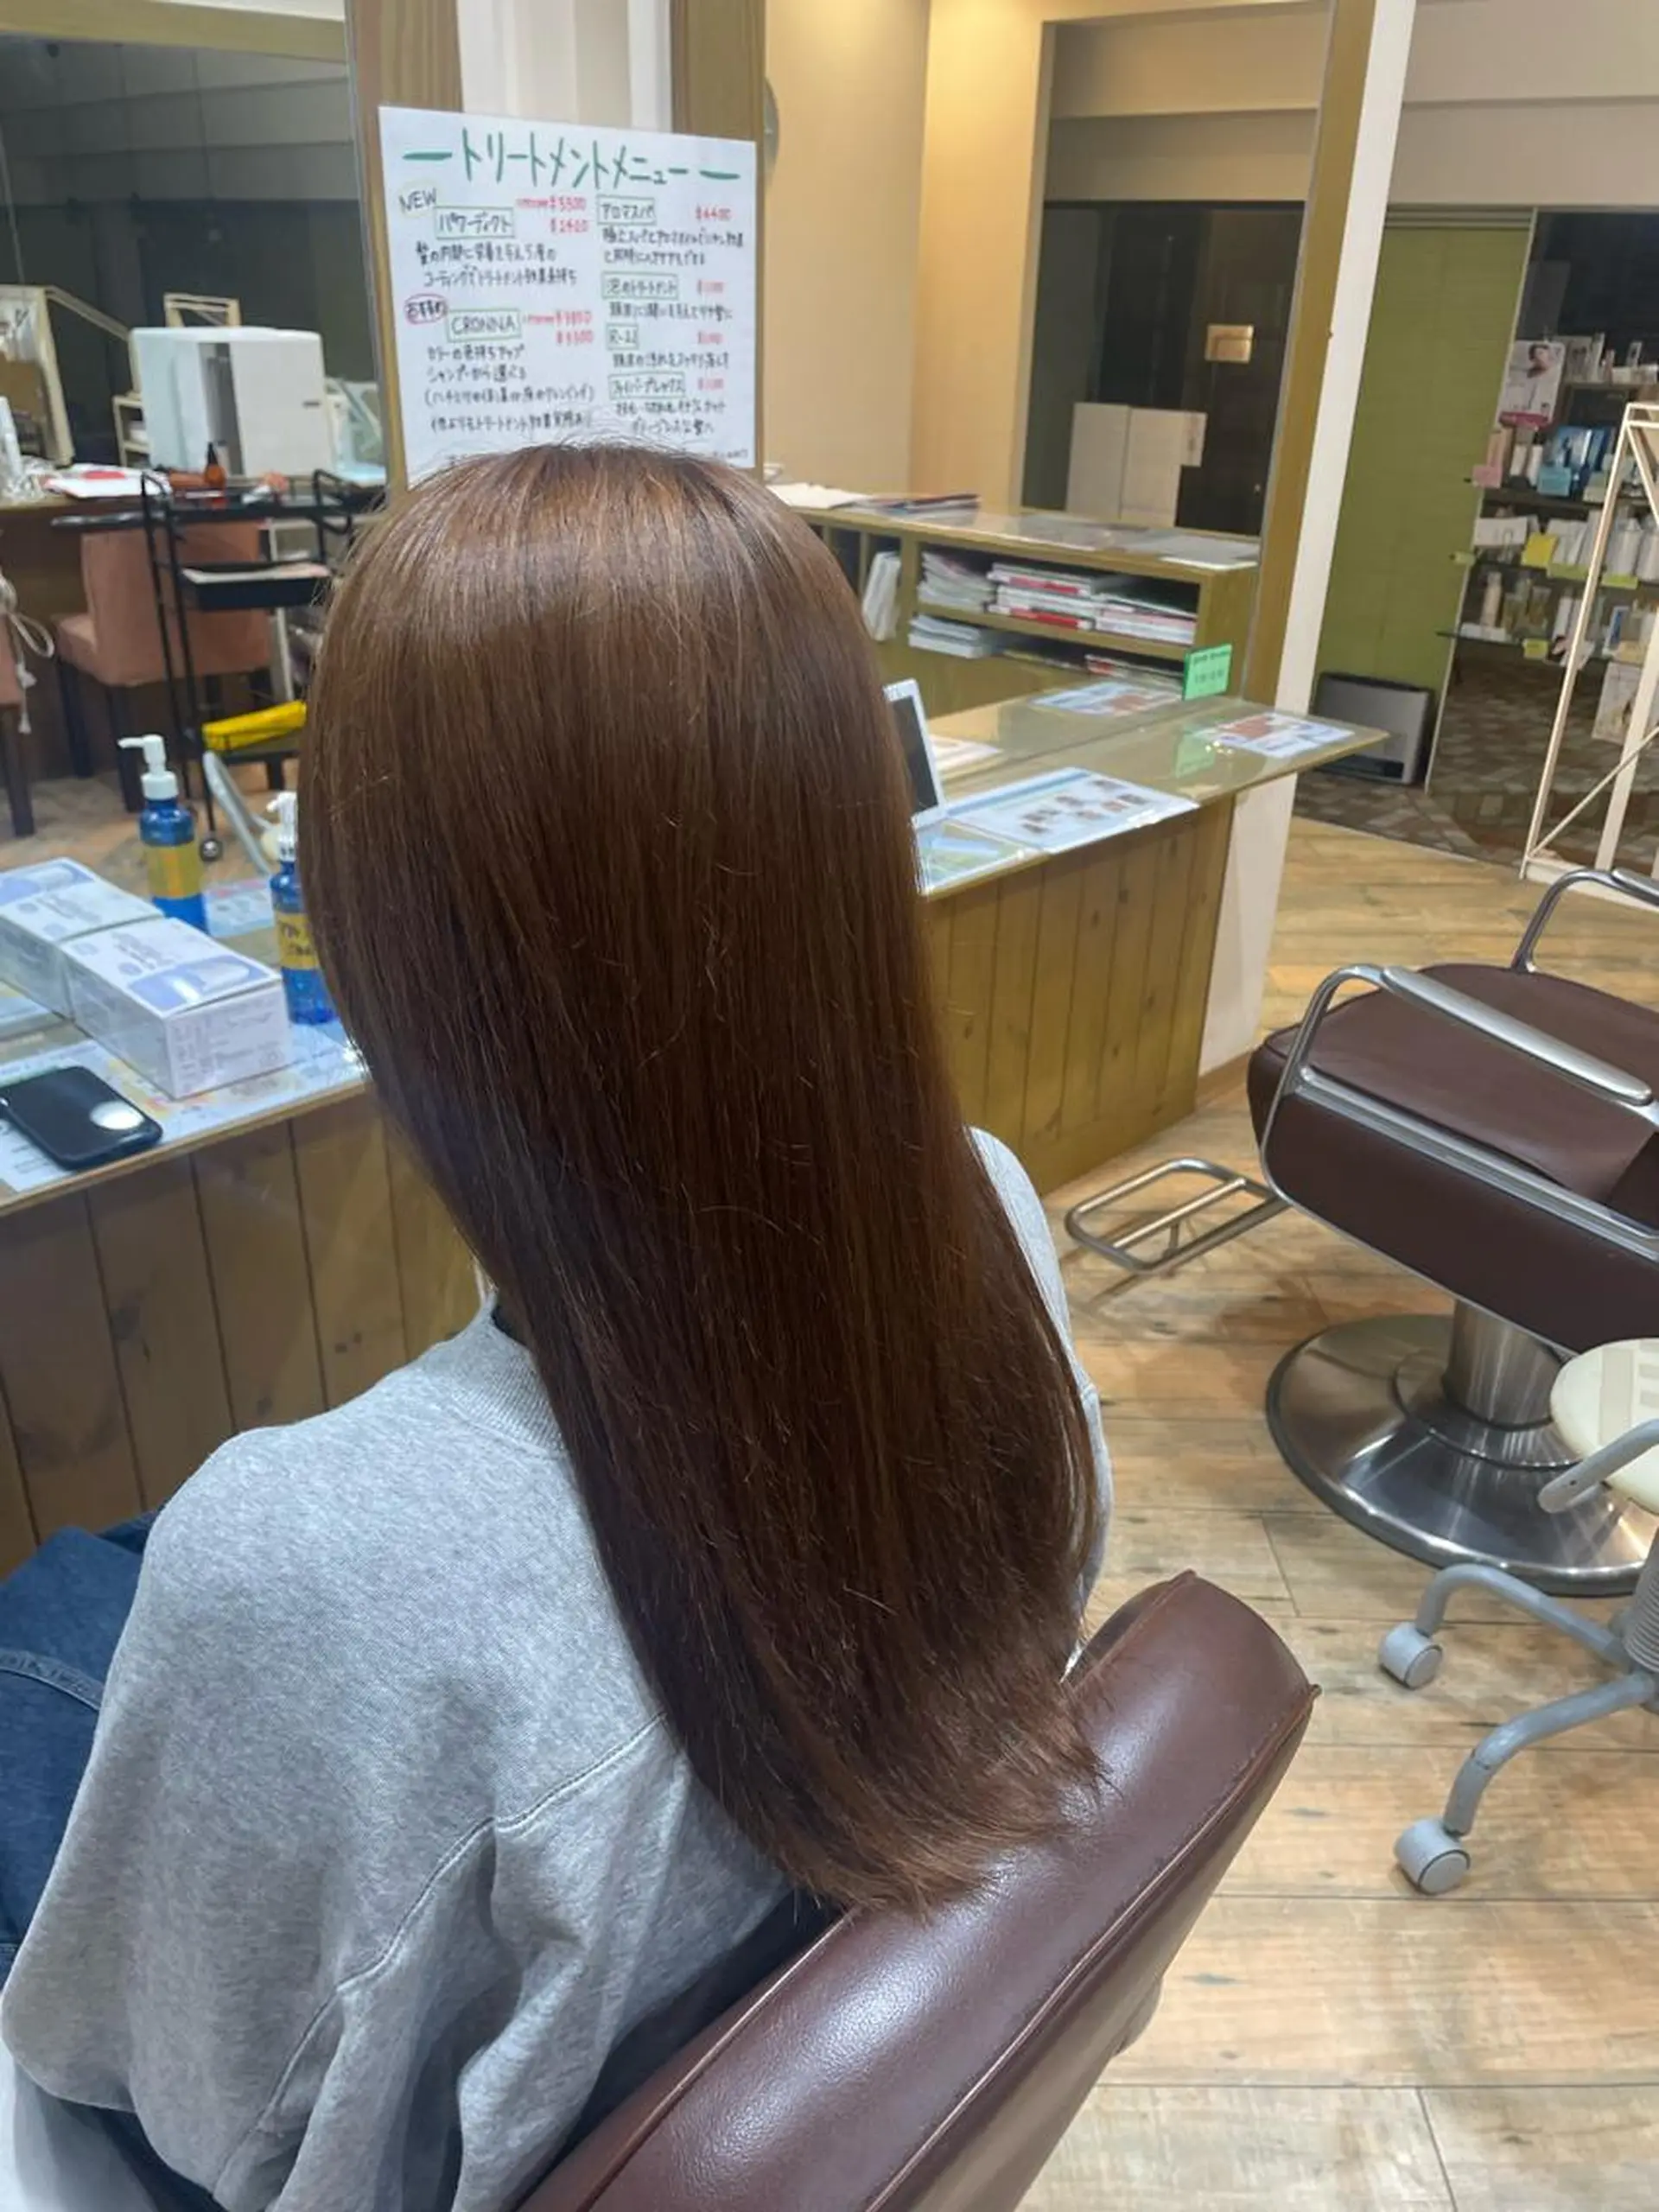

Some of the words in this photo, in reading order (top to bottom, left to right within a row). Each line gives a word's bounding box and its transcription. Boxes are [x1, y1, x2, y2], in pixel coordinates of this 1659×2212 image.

[462, 127, 689, 188] トリートメントメニュー
[398, 188, 437, 213] NEW
[451, 315, 517, 335] CRONNA
